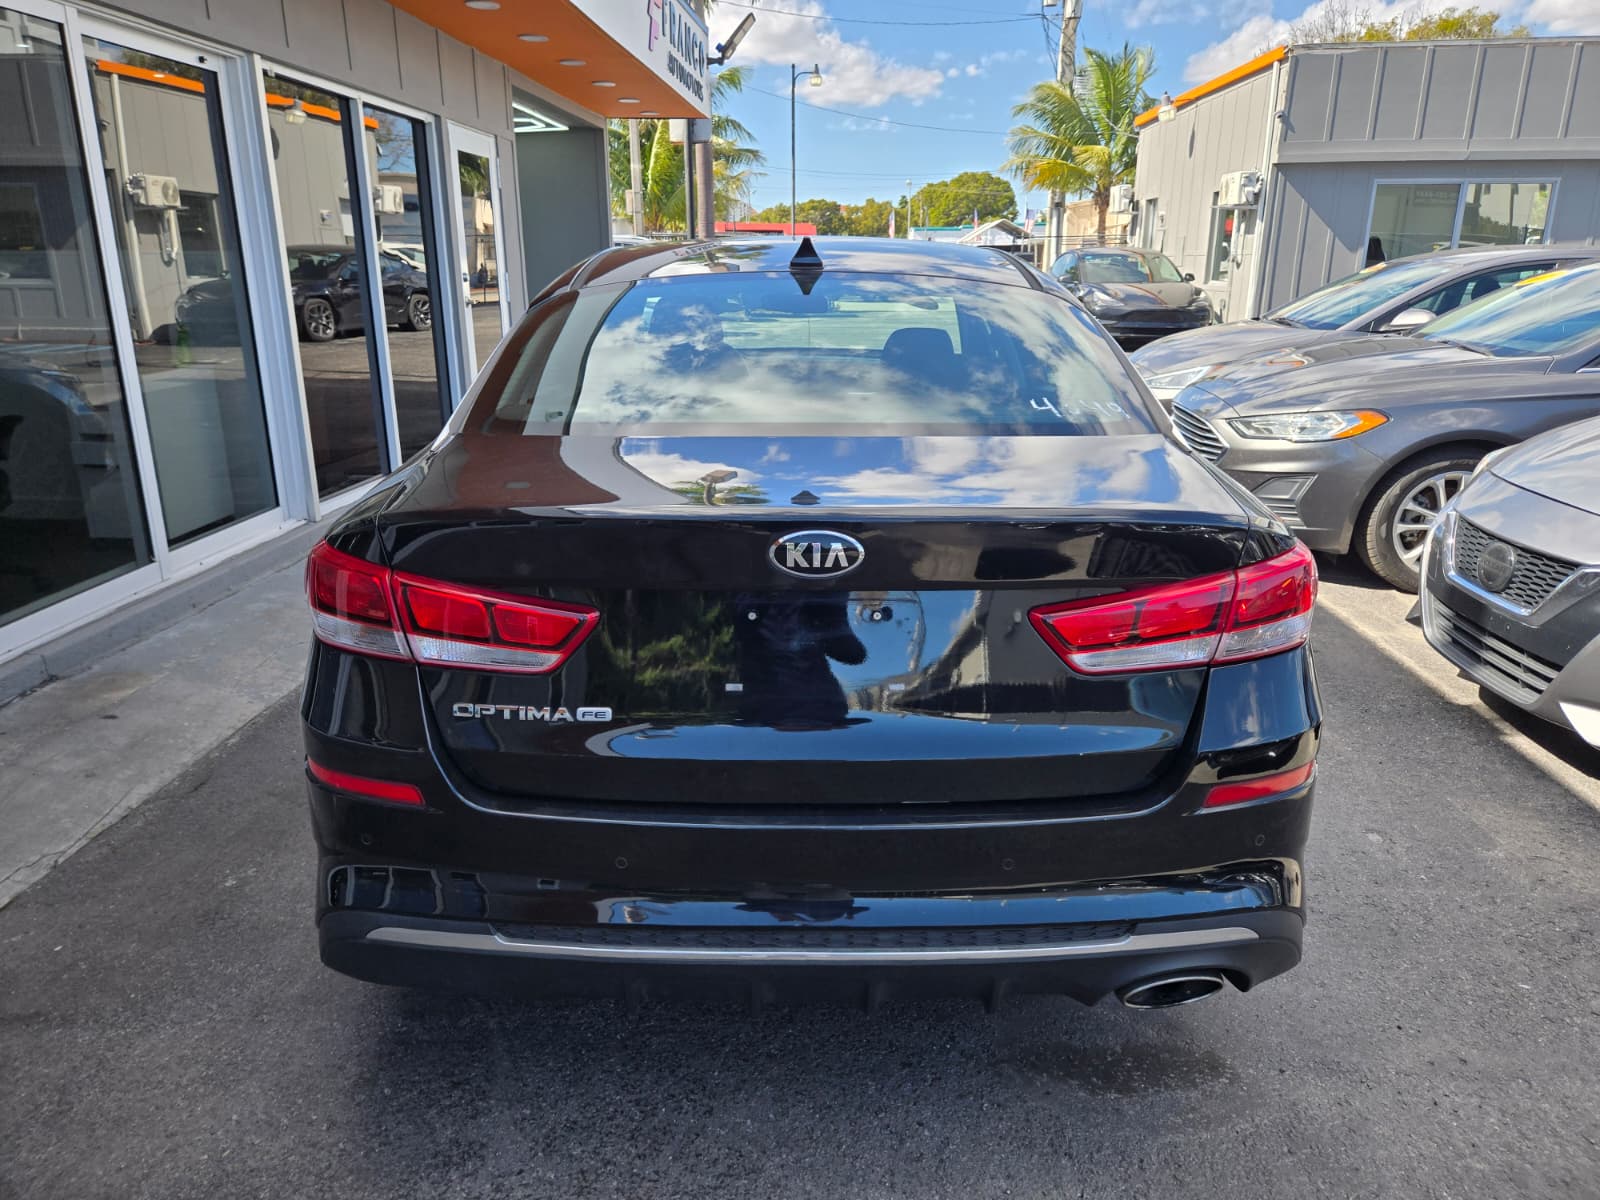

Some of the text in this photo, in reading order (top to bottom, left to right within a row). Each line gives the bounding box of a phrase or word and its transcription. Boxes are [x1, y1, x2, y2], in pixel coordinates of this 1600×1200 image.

[785, 542, 849, 568] KIA
[452, 702, 609, 722] OPTIMA FE
